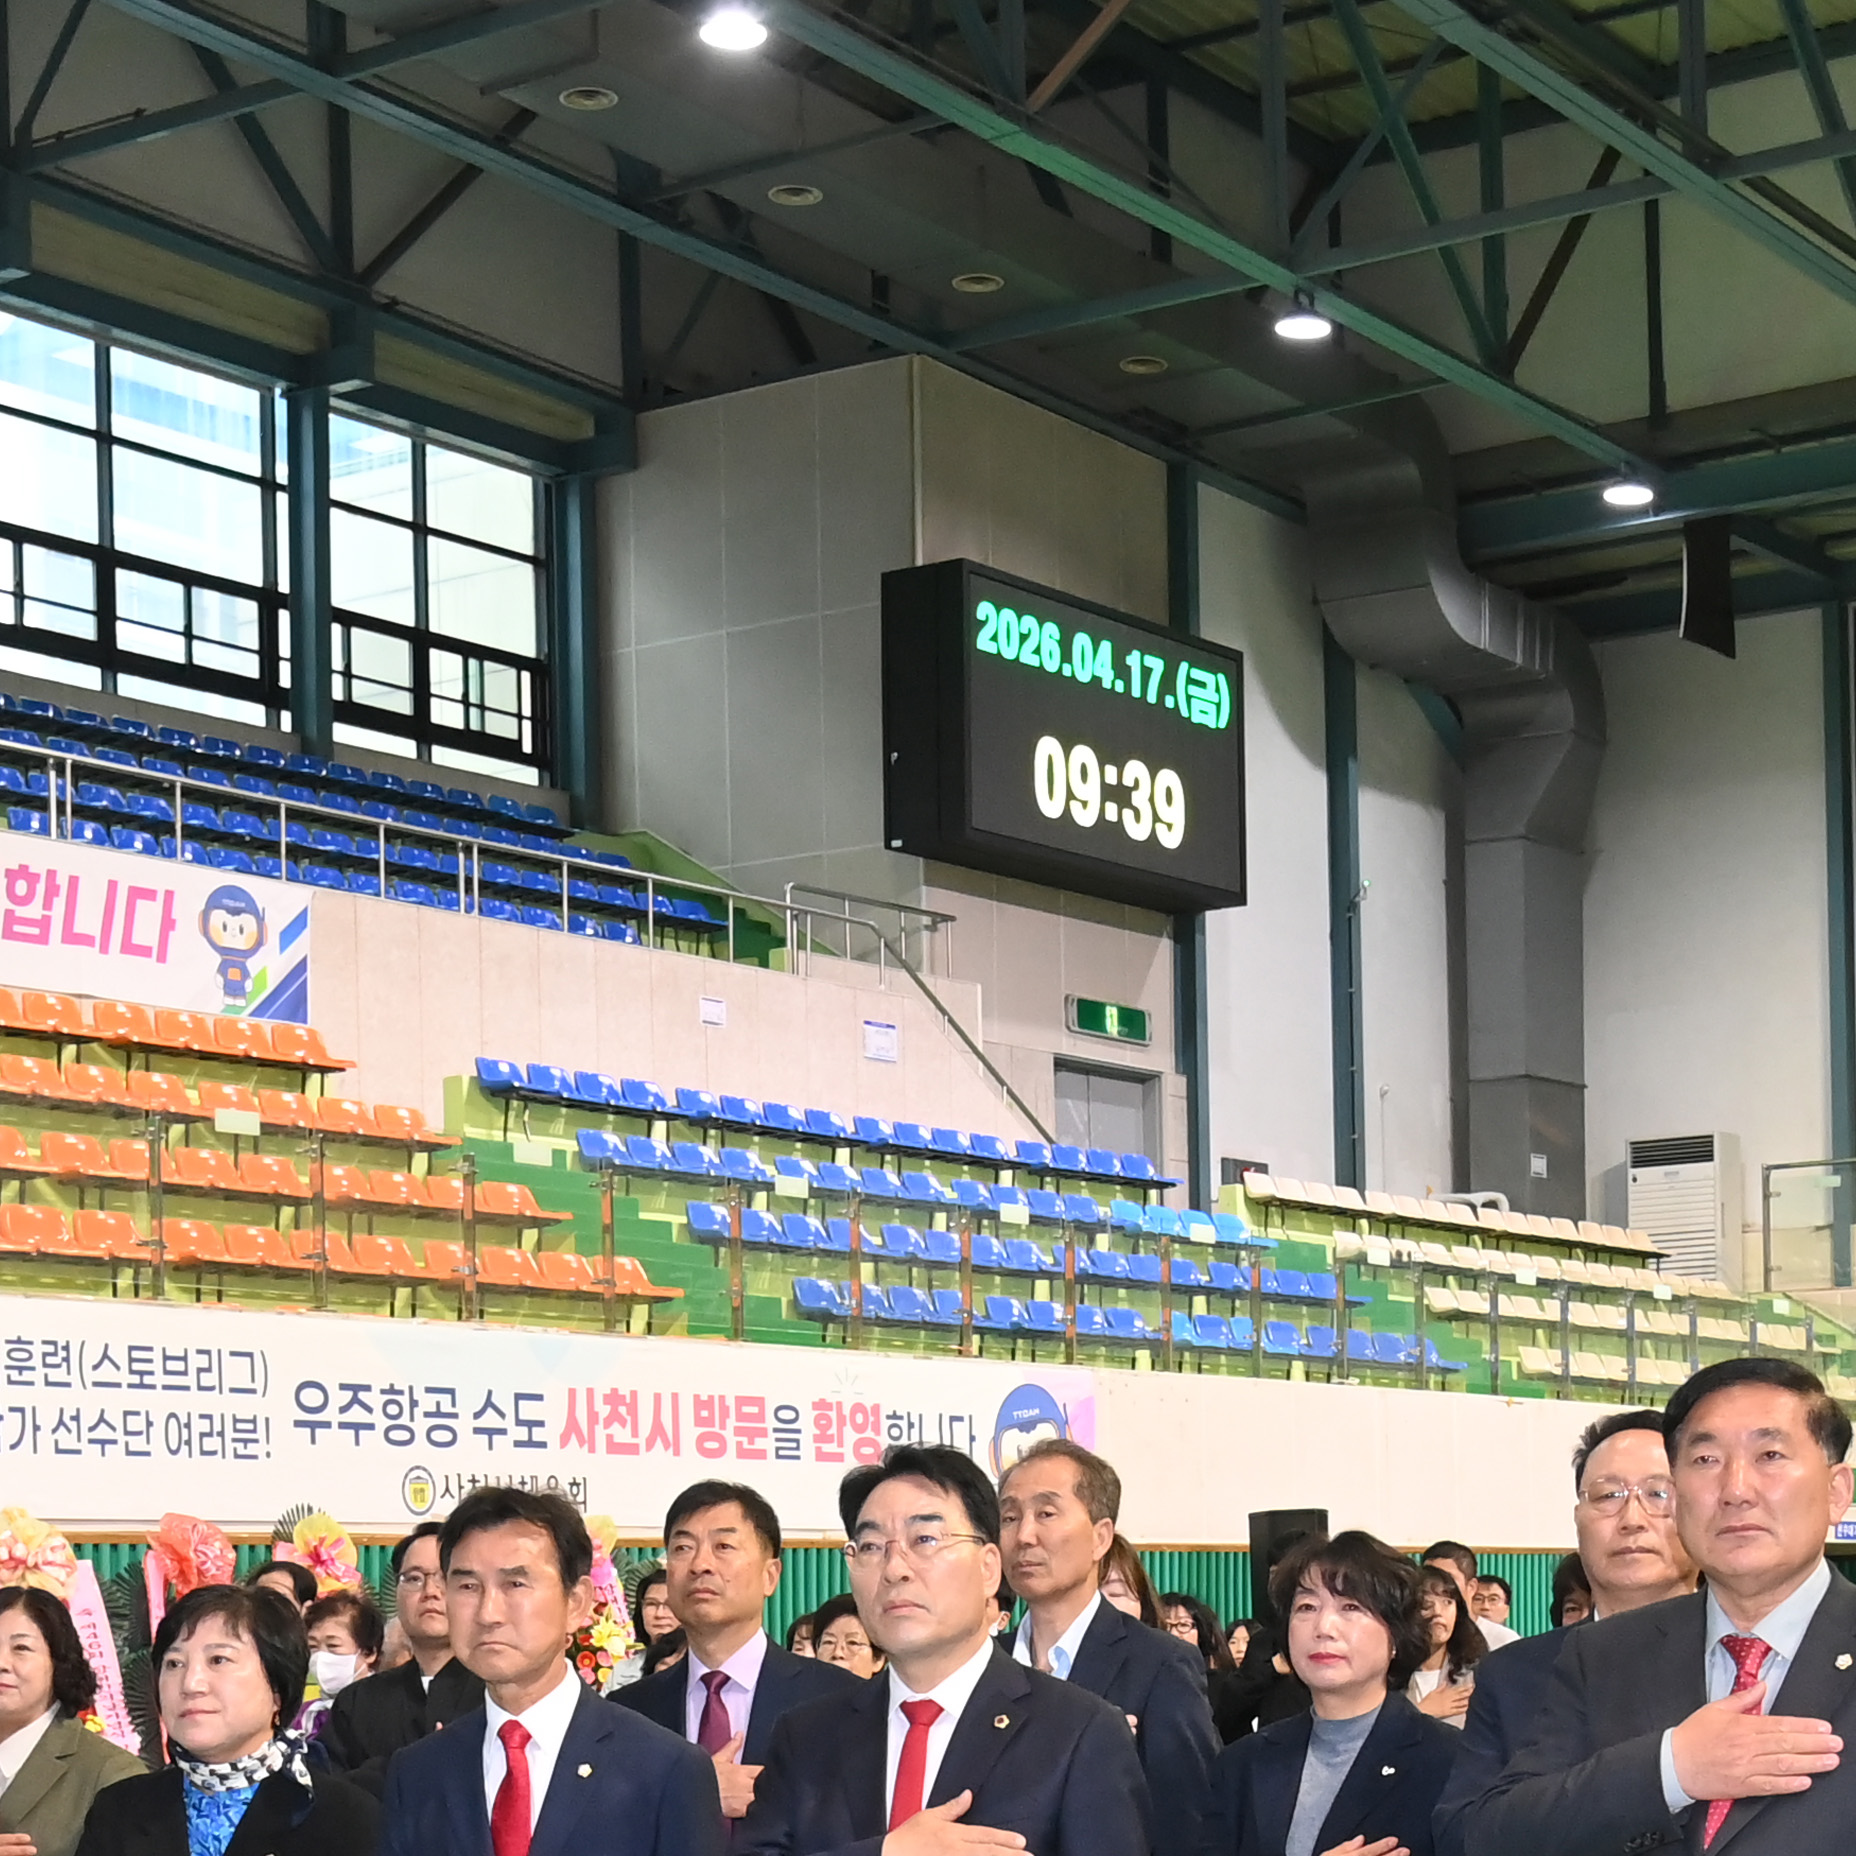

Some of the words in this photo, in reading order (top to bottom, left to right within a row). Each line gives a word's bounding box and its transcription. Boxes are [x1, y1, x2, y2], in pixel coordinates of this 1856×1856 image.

[975, 600, 1231, 729] 2026.04.17.(금)
[1034, 735, 1186, 849] 09:39
[50, 1410, 154, 1457] 선수단
[164, 1412, 272, 1460] 여러분!
[293, 1379, 460, 1449] 우주항공
[472, 1388, 546, 1450] 수도
[559, 1386, 682, 1458] 사천시
[692, 1394, 804, 1462] 방문을
